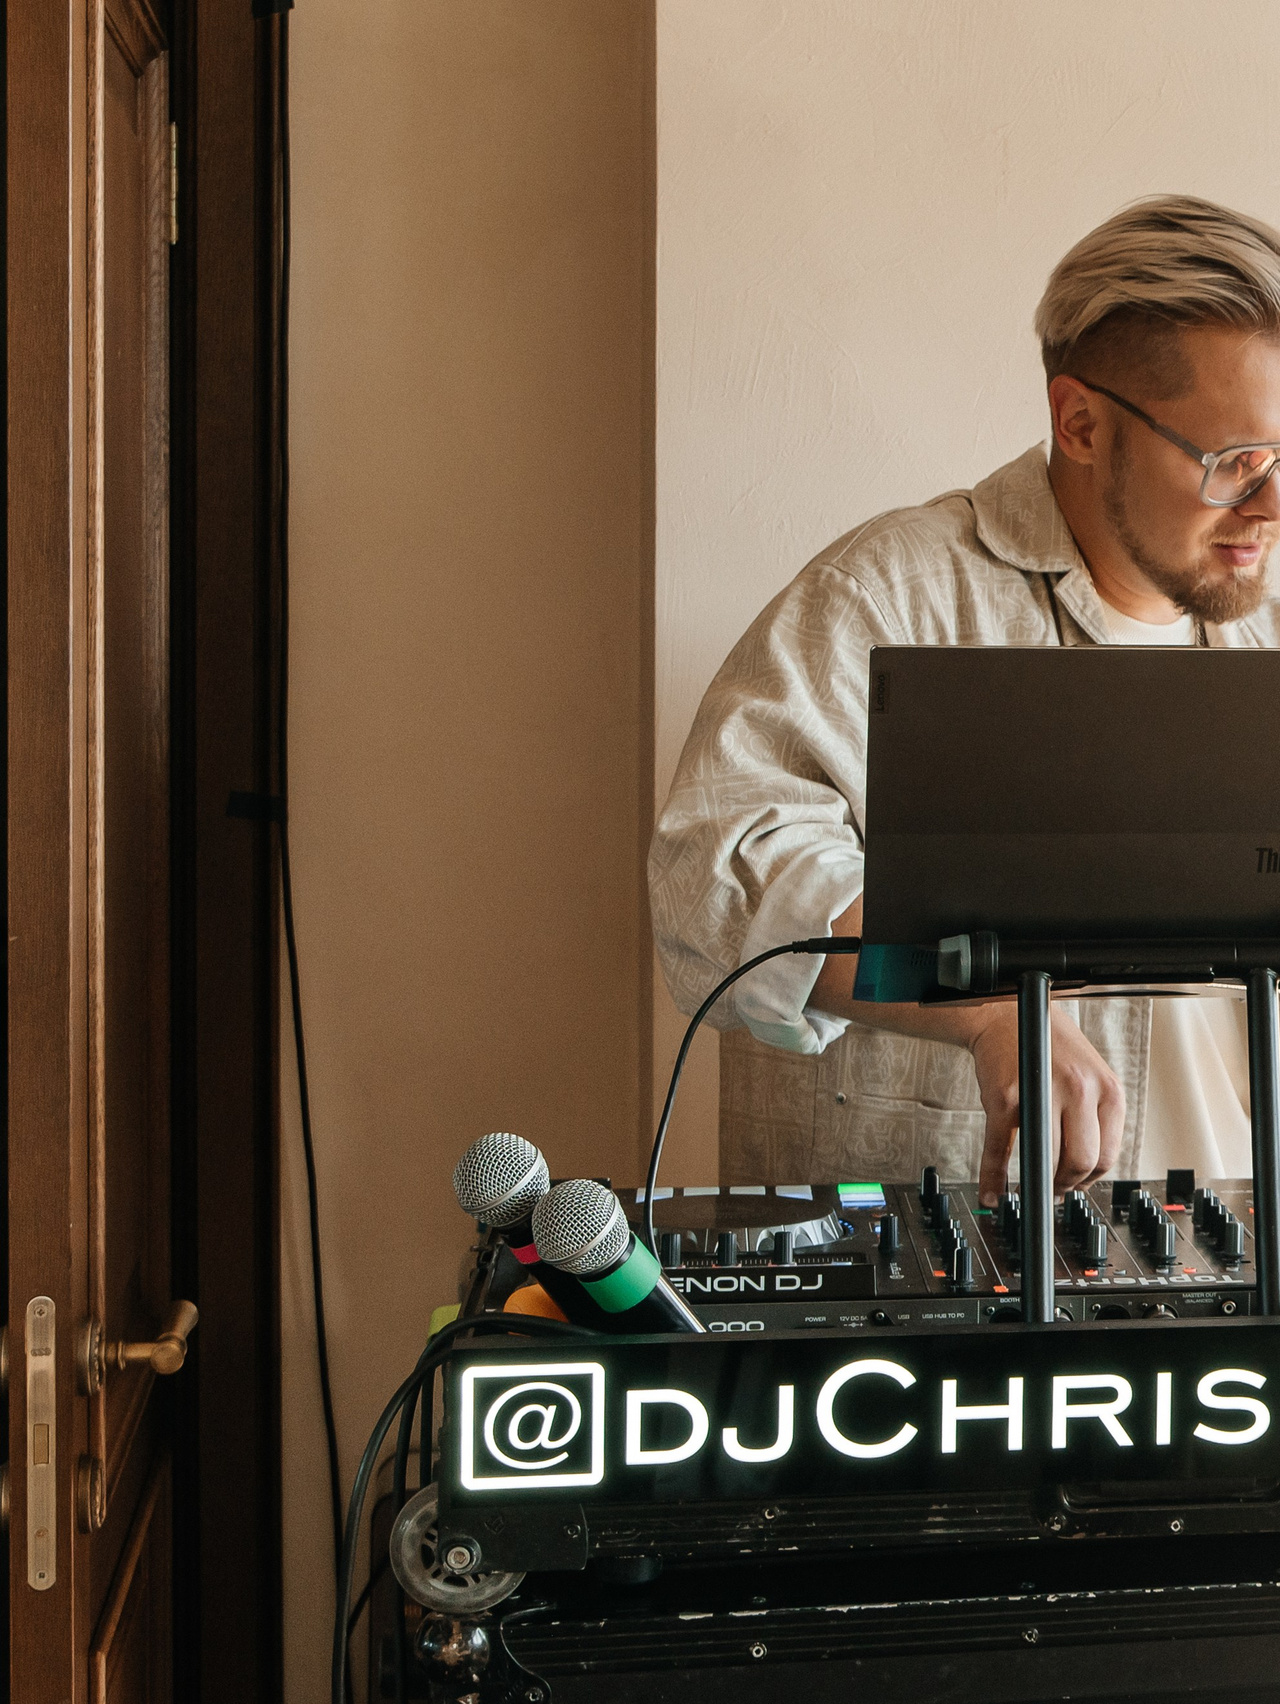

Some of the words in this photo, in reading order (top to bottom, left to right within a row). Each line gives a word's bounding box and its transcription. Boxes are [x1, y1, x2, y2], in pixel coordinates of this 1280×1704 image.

[875, 674, 885, 711] Lenovo
[669, 1276, 765, 1293] ENON
[775, 1274, 823, 1291] DJ
[1054, 1274, 1245, 1287] TopHertz
